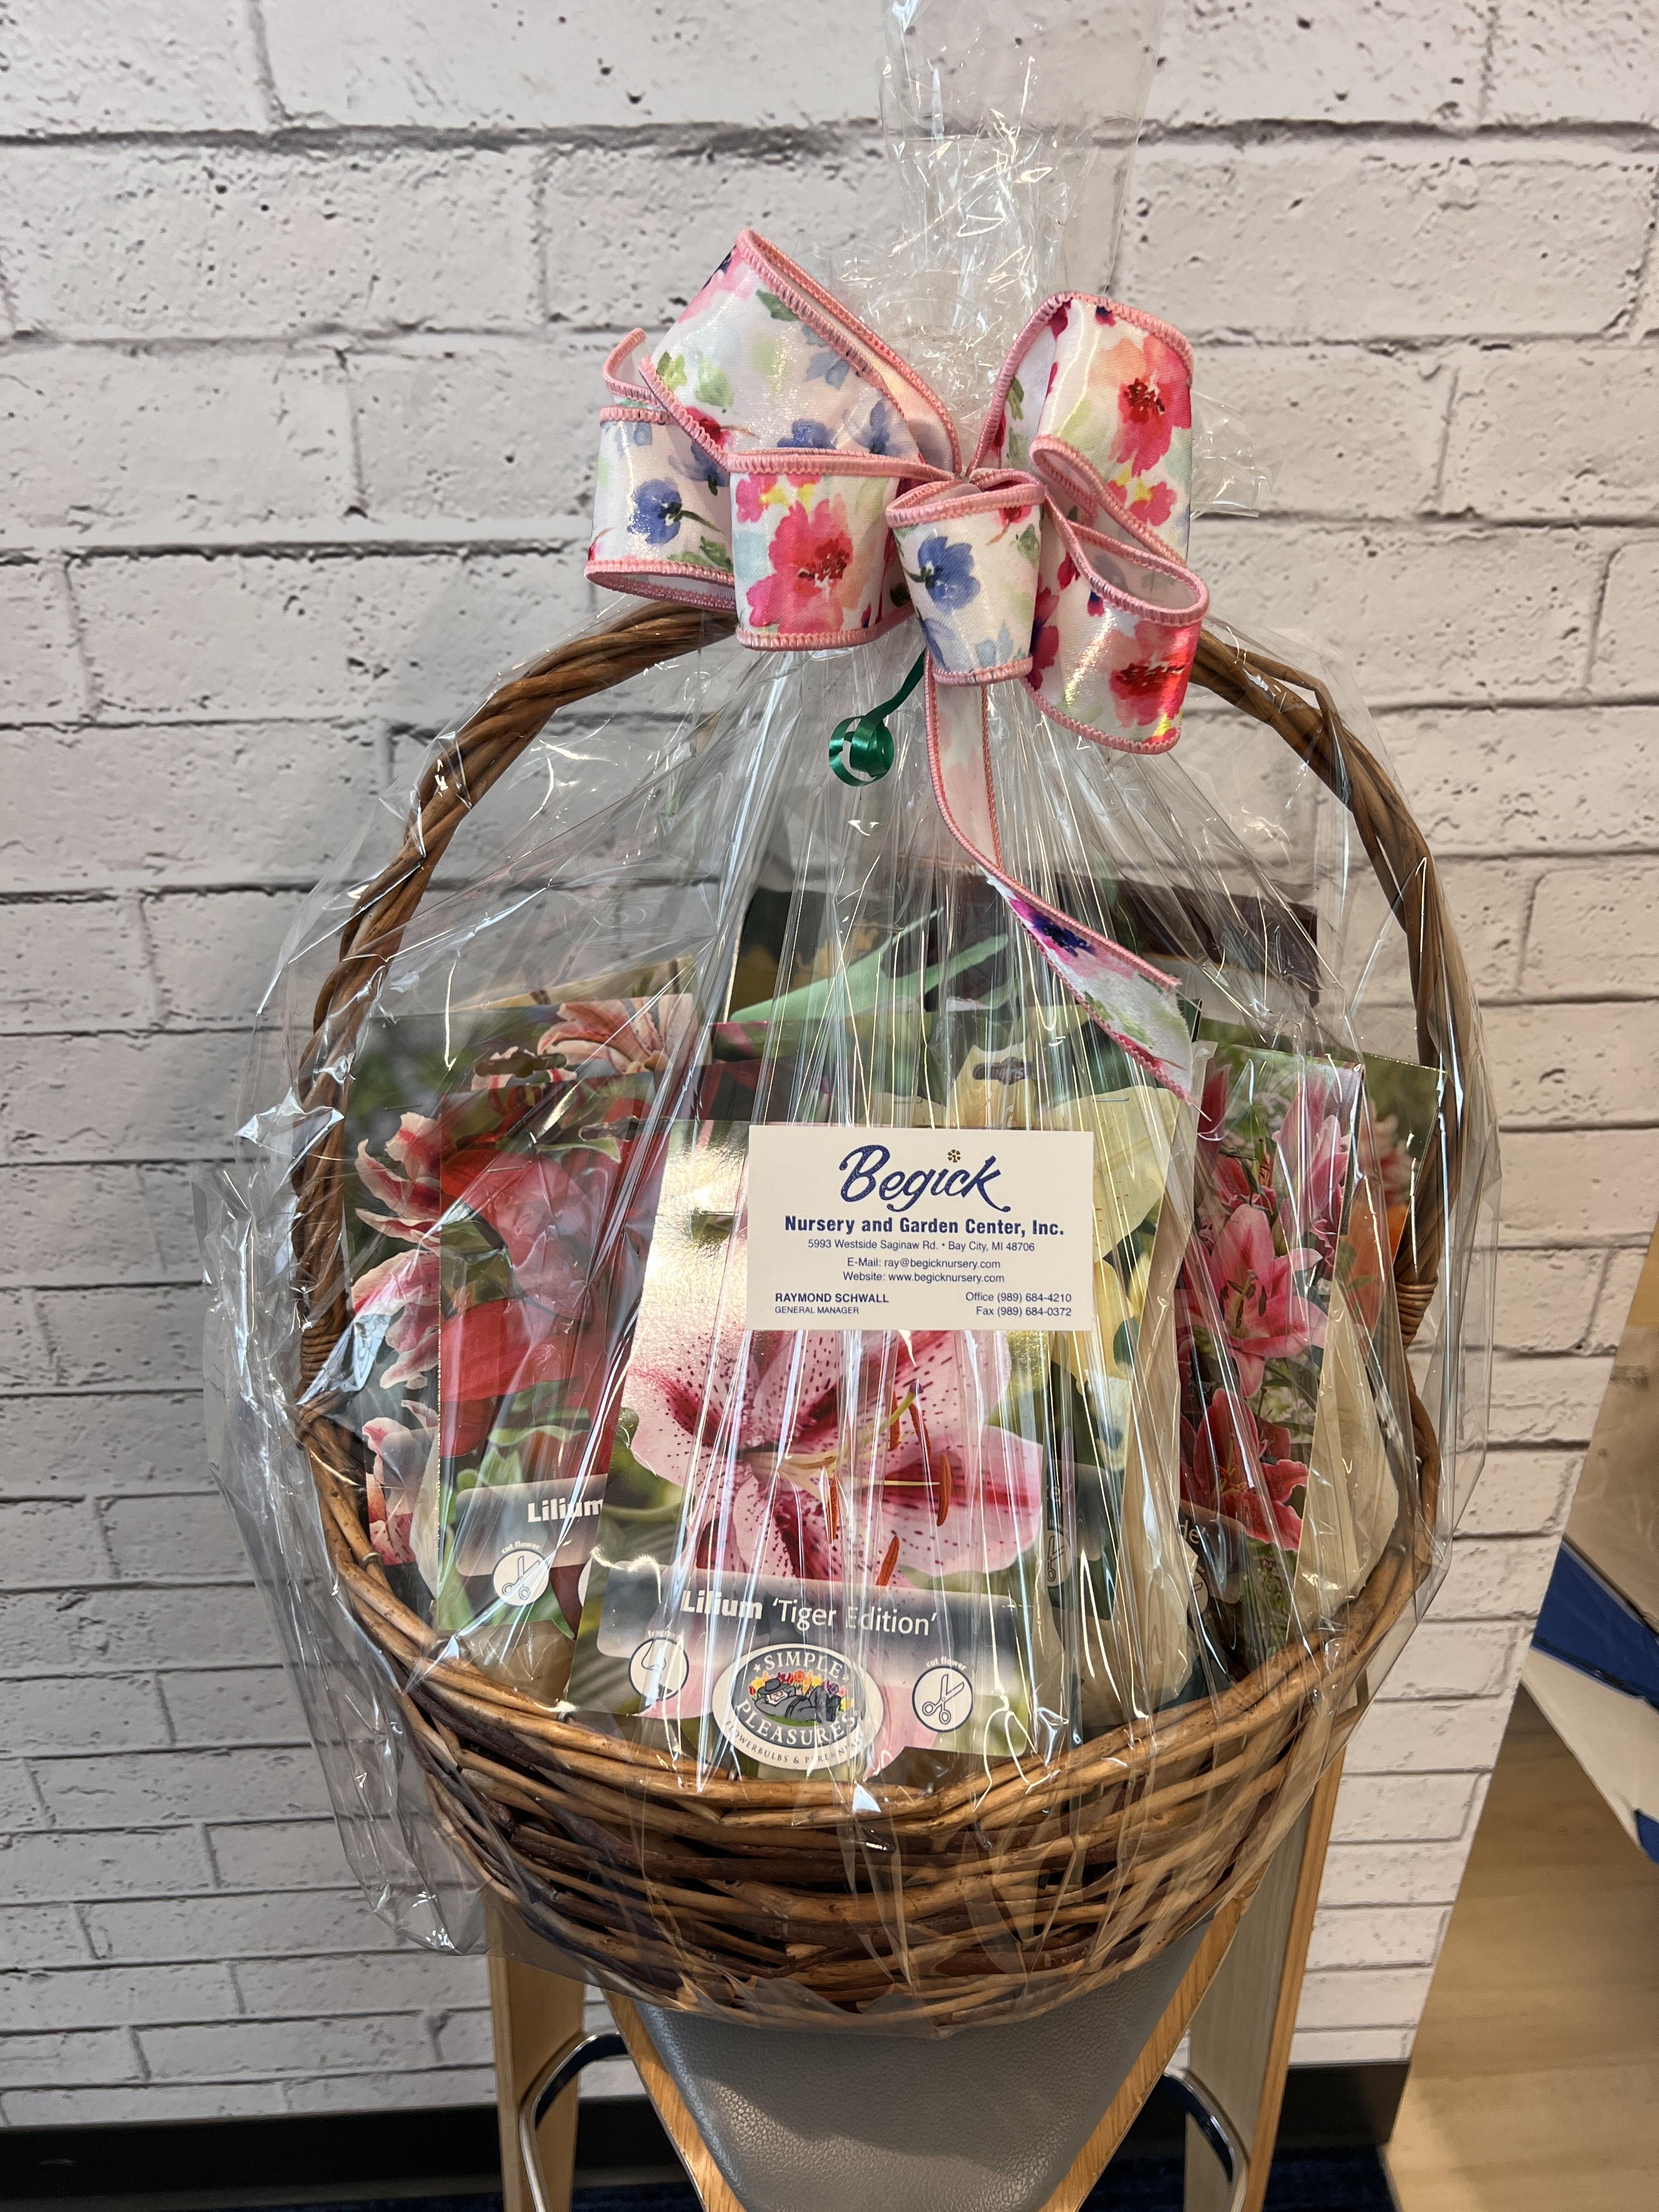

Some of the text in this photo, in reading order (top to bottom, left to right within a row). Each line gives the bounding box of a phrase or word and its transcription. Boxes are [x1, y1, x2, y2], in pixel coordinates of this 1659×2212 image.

[839, 1144, 1011, 1212] Begick
[785, 1215, 1064, 1237] Nursery and Garden Center, Inc.
[808, 1239, 1035, 1252] 5993 Westside Saginaw Rd. Bay City, MI 48706
[848, 1257, 1001, 1269] E-Mail: ray@begicknursery.com
[843, 1271, 1005, 1284] Website: www.begicknursery.com
[775, 1293, 889, 1303] RAYMOND SCHWALL
[966, 1291, 1072, 1304] Office (989) 684-4210
[775, 1306, 859, 1314] GENERAL MANAGER
[976, 1306, 1072, 1317] Fax (989) 684-0372
[528, 1497, 604, 1523] Lilium
[501, 1541, 540, 1554] cut flower
[681, 1590, 763, 1620] Lilium
[764, 1651, 843, 1679] SIMPLE
[926, 1656, 967, 1671] cut flower
[736, 1699, 856, 1746] PLEASURES
